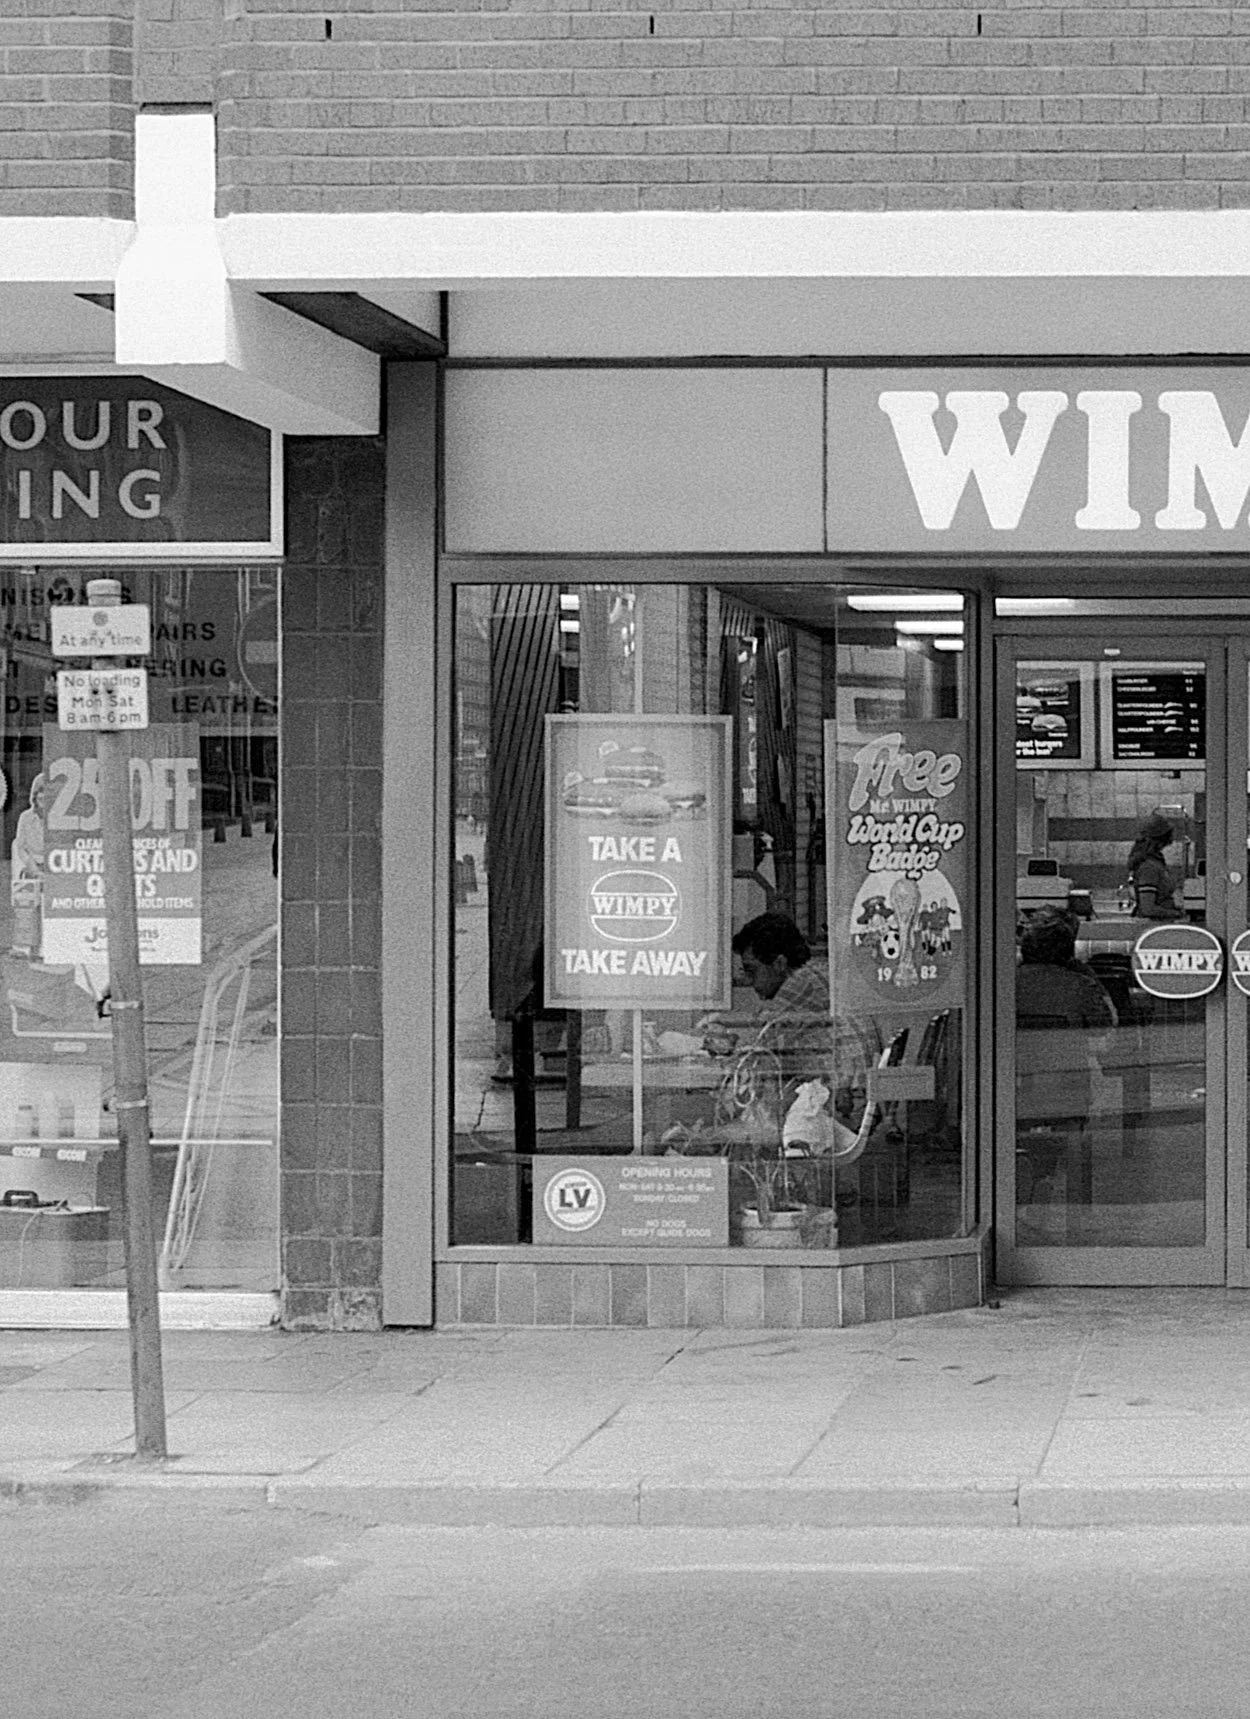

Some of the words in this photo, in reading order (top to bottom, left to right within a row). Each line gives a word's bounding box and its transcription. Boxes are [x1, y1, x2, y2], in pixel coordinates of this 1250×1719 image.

[0, 400, 167, 450] OUR
[18, 468, 161, 519] ING
[59, 634, 77, 646] At
[81, 633, 106, 648] any
[110, 631, 143, 646] time
[64, 676, 84, 687] No
[87, 674, 141, 688] loading
[848, 732, 962, 811] Free
[128, 757, 198, 831] OFF
[847, 814, 916, 845] World
[914, 813, 965, 850] Cup
[151, 849, 198, 873] AND
[587, 836, 656, 862] TAKE
[661, 837, 683, 863] A
[867, 843, 940, 880] Badge
[593, 895, 677, 916] WIMPY
[562, 949, 627, 974] TAKE
[630, 950, 707, 976] AWAY
[877, 967, 892, 982] 19
[920, 965, 937, 980] 82
[1138, 952, 1220, 971] WIMPY
[621, 1167, 671, 1178] OPENING
[674, 1167, 712, 1178] HOURS
[559, 1188, 591, 1208] LV
